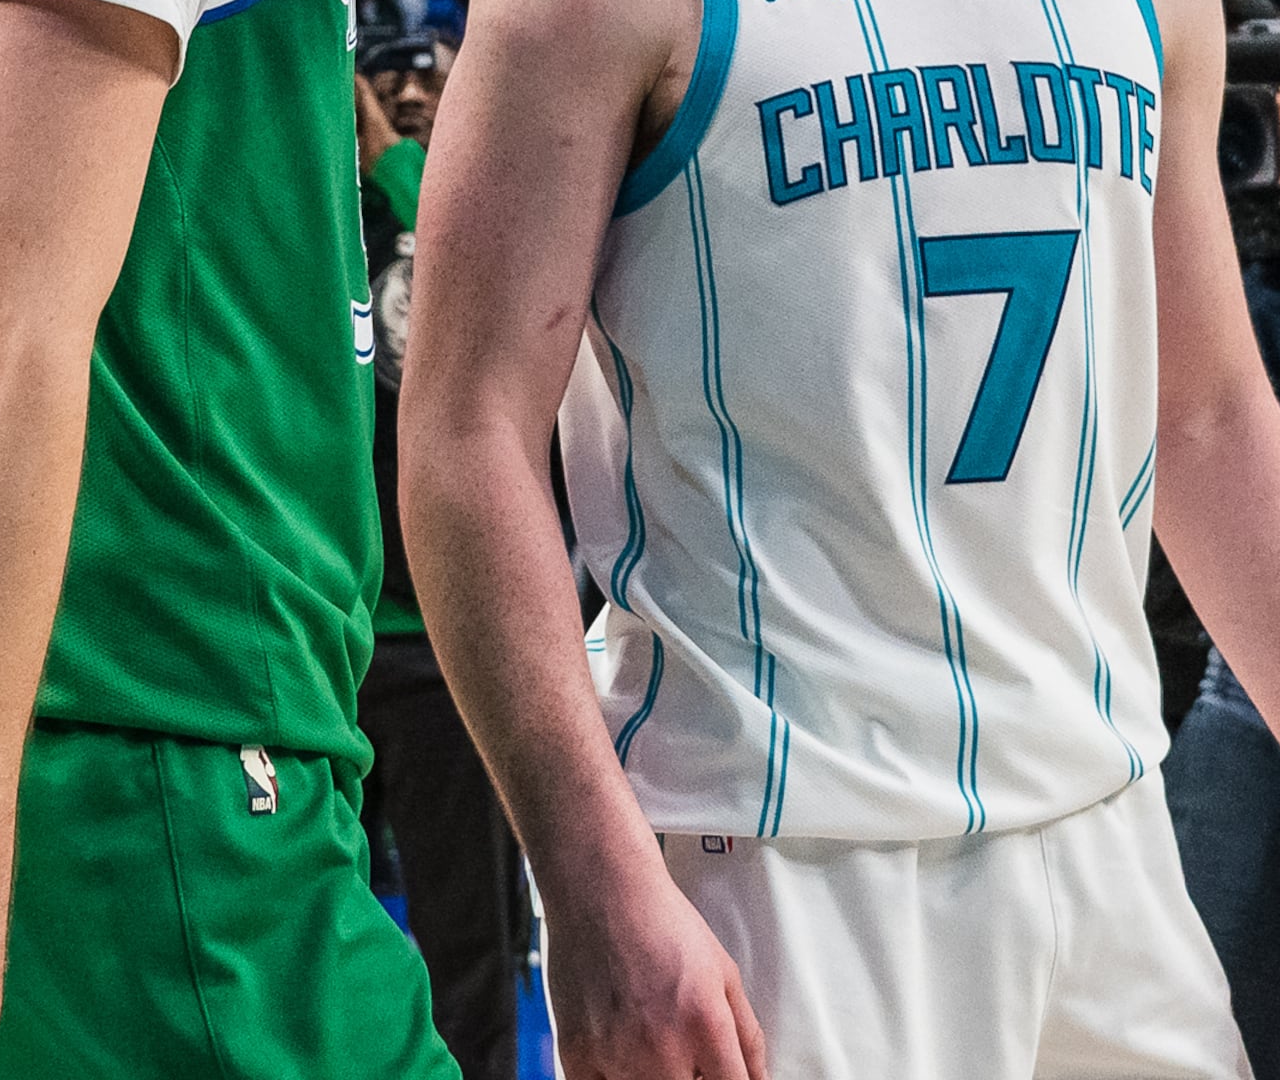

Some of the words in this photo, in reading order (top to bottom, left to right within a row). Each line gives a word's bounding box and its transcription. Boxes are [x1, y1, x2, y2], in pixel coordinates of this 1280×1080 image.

[754, 60, 1157, 207] CHARLOTTE
[918, 228, 1082, 485] 7
[252, 796, 272, 812] NBA
